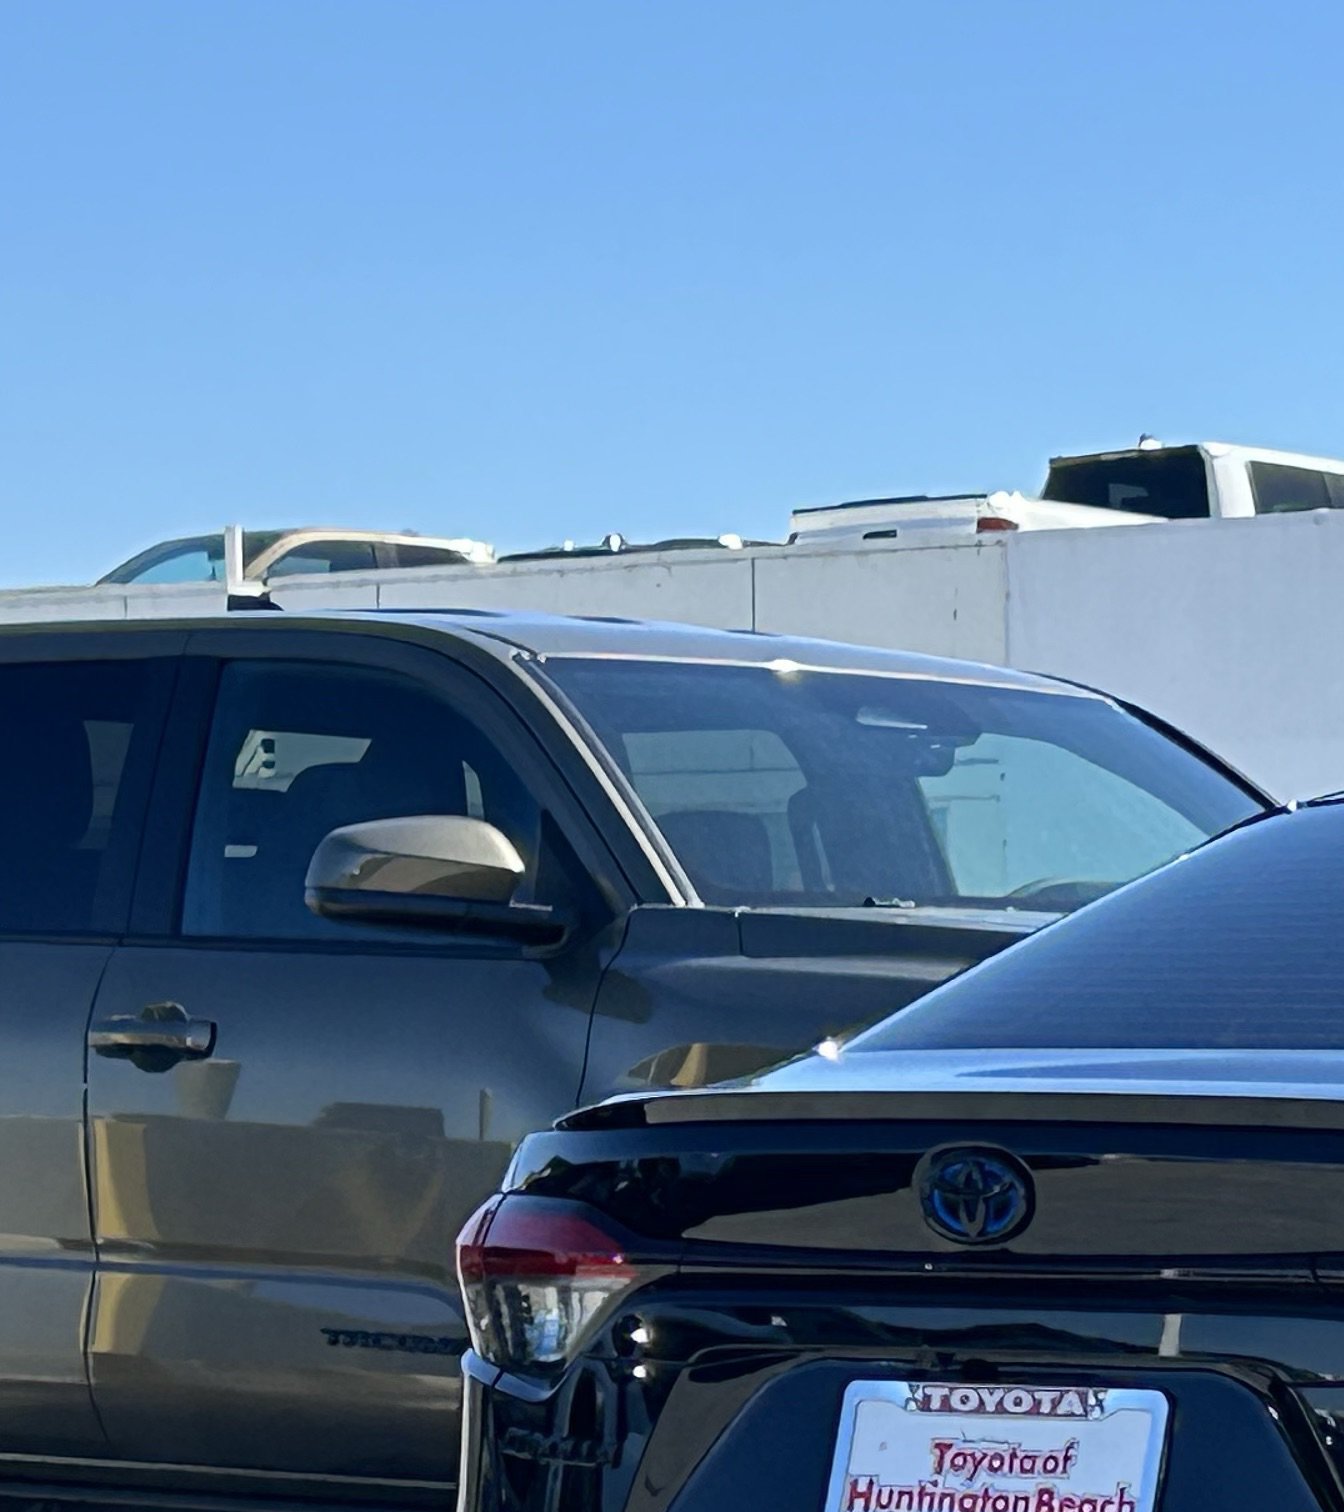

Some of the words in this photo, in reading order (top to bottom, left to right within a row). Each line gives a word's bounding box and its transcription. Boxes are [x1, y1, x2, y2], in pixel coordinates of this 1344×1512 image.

[923, 1387, 1086, 1415] TOYOTA
[932, 1440, 1037, 1481] Toyota
[1042, 1439, 1079, 1475] of
